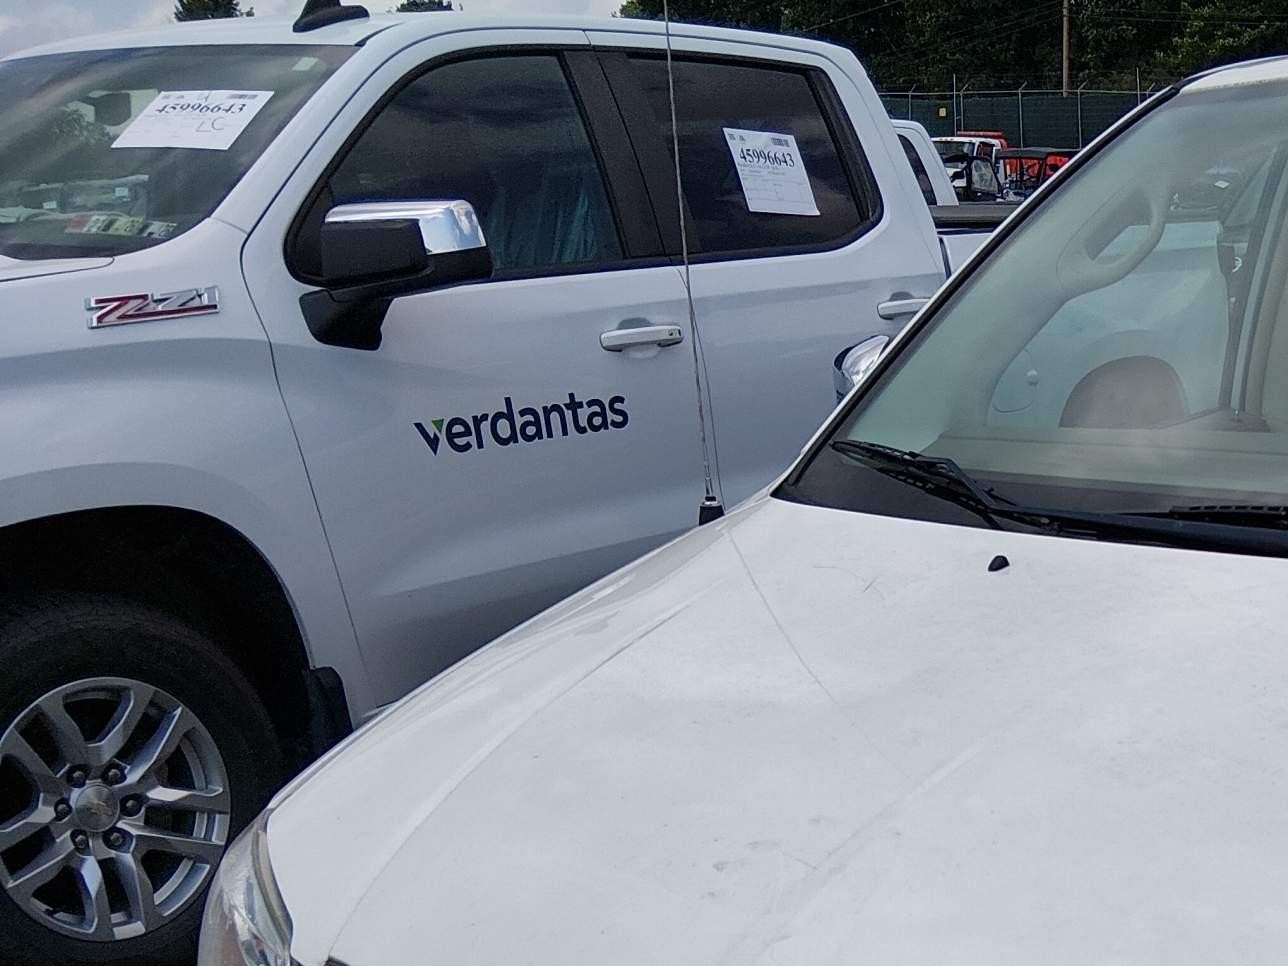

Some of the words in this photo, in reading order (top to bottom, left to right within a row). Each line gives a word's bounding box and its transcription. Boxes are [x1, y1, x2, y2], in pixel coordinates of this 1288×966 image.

[155, 102, 247, 114] 45996643
[739, 147, 795, 168] 45996643
[412, 392, 629, 456] verdantas
